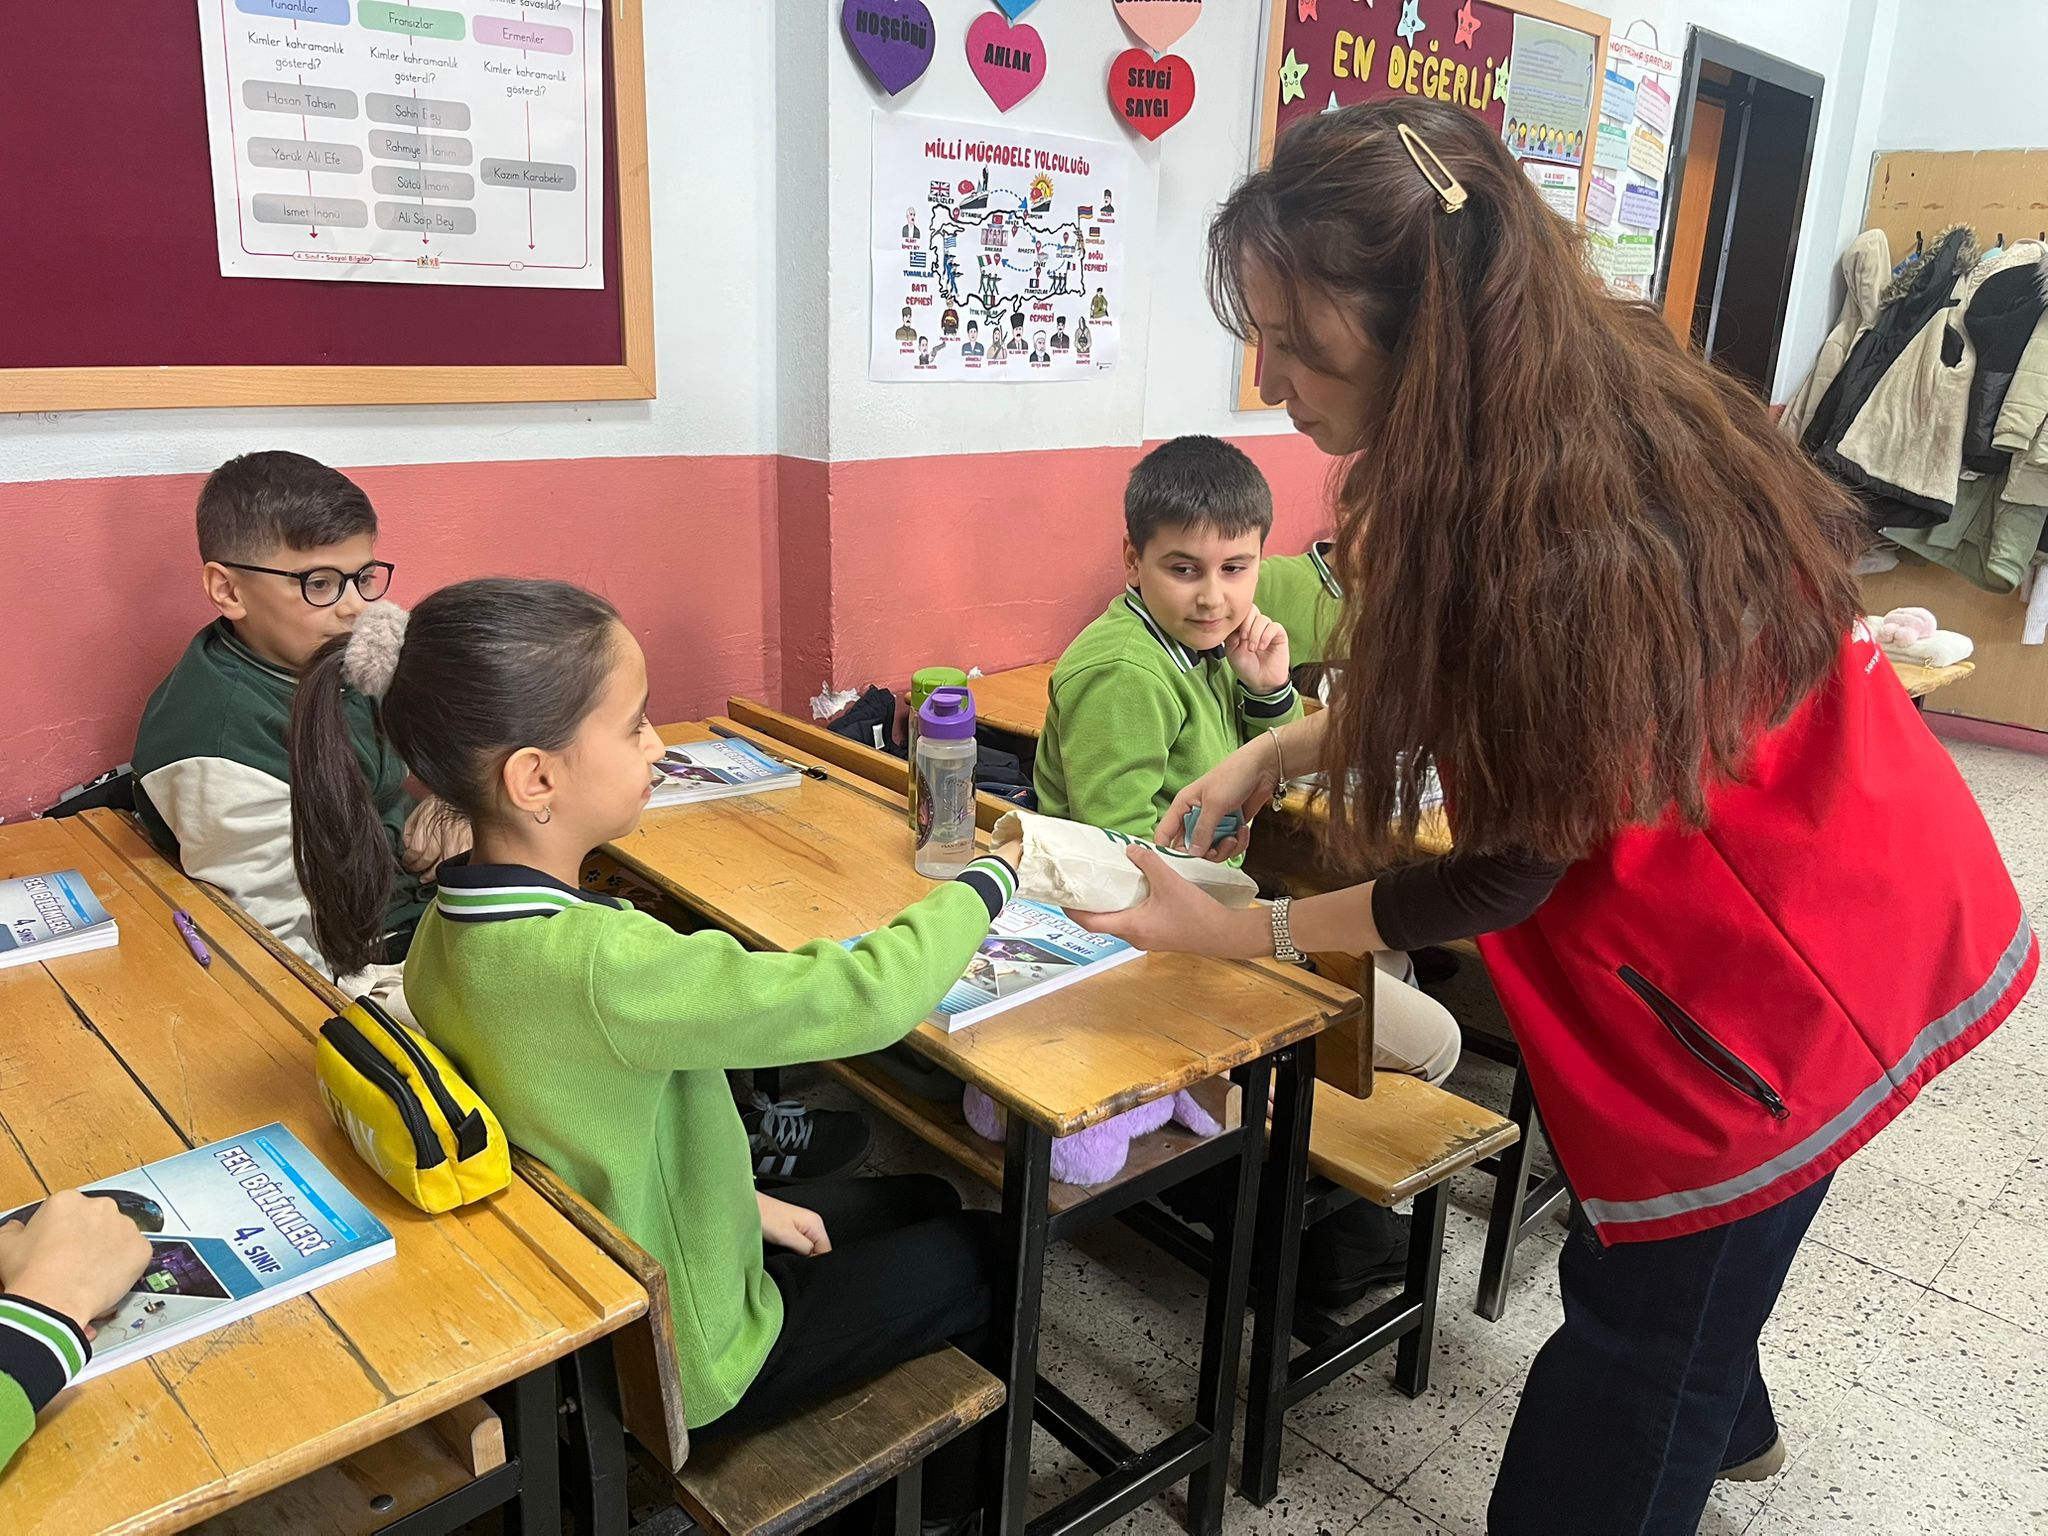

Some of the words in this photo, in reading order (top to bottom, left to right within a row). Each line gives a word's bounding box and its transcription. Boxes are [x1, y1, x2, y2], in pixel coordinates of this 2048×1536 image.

[388, 11, 434, 30] Fransızlar
[856, 9, 927, 50] HOŞGÖRÜ
[248, 31, 281, 47] Kimler
[285, 36, 345, 55] kahramanlık
[502, 27, 545, 45] Ermeniler
[275, 58, 322, 71] gösterdi?
[369, 46, 400, 61] Kimler
[403, 50, 459, 68] kahramanlık
[984, 43, 1032, 73] AHLAK
[483, 61, 512, 75] Kimler
[1333, 30, 1376, 82] EN
[1387, 39, 1494, 112] DEĞERLİ
[394, 72, 436, 85] gösterdi?
[1127, 66, 1172, 91] SEVGİ
[266, 90, 301, 106] Hasan
[304, 94, 337, 110] Tahsin
[506, 85, 547, 98] gösterdi?
[1125, 98, 1169, 118] SAYGI
[324, 152, 341, 165] Efe
[385, 139, 421, 159] Rahmiye
[925, 138, 962, 160] MİLLİ
[965, 141, 1031, 169] MÜCADELE
[1034, 149, 1090, 176] YOLCULUĞU
[493, 167, 520, 180] Kazım
[398, 212, 411, 224] Ali
[436, 214, 455, 230] Bey
[1005, 900, 1027, 912] EN
[1062, 941, 1096, 956] SINIF
[213, 1145, 261, 1176] FEN
[238, 1172, 337, 1258] BİLİMLERİ
[233, 1226, 266, 1247] 4.
[244, 1245, 282, 1274] SINIF
